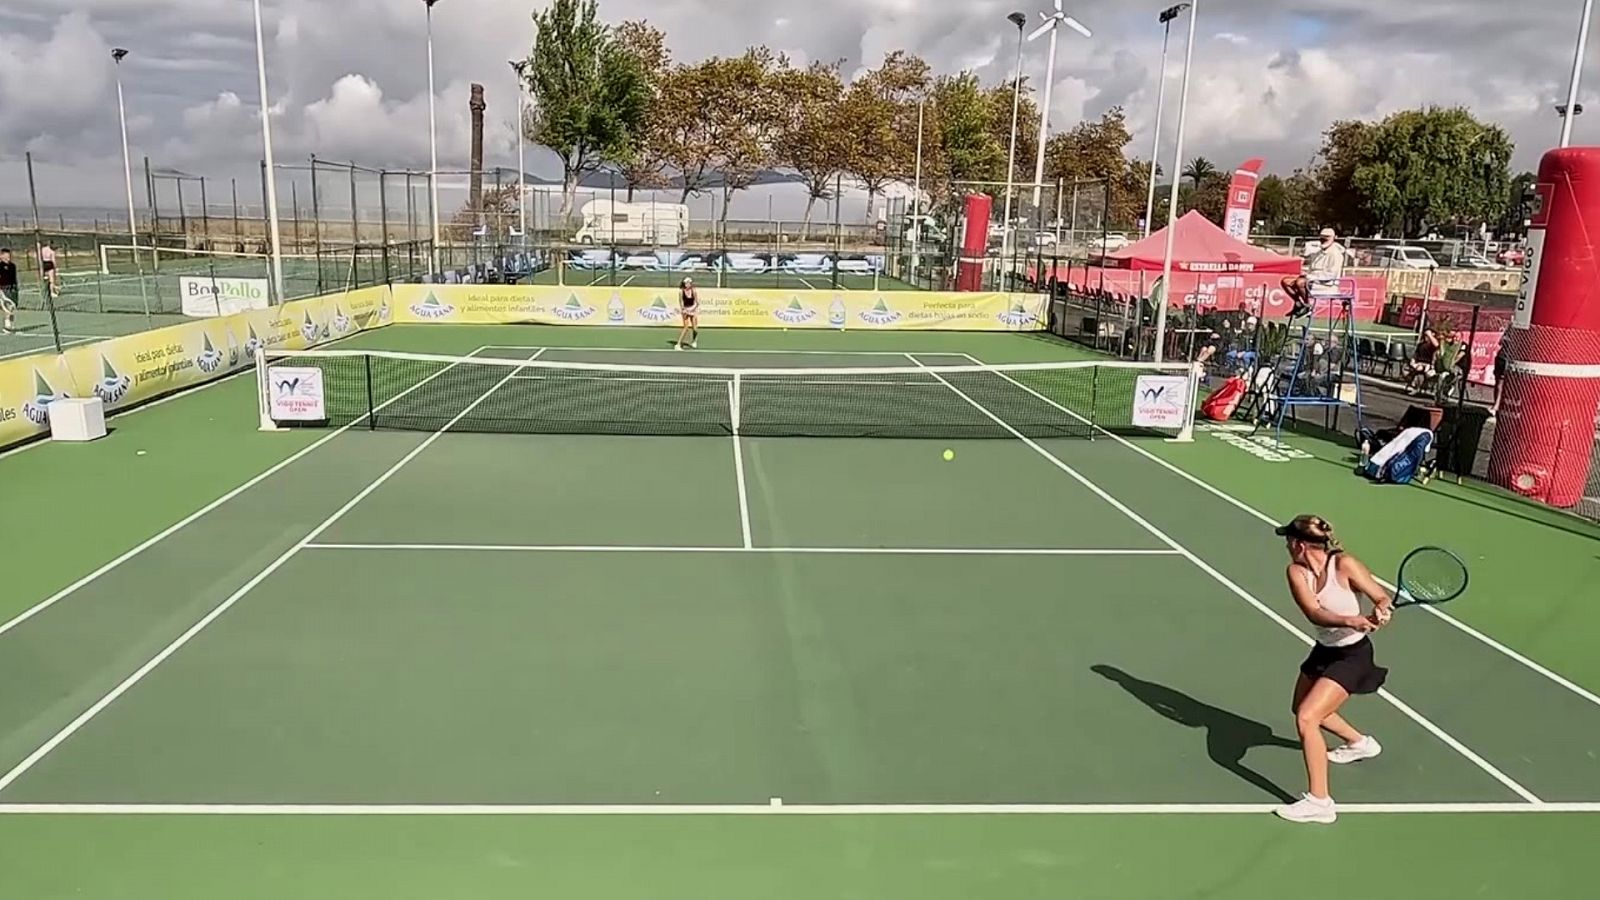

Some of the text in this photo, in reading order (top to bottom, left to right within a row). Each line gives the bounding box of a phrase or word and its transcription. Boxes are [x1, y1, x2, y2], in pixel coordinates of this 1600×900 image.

[1189, 262, 1227, 271] ESTRELLA
[1517, 290, 1527, 311] DE
[409, 305, 455, 318] AGUA SANA
[552, 307, 596, 321] AGUA SANA
[774, 309, 817, 323] AGUA SANA
[858, 312, 902, 325] AGUA SANA
[93, 375, 131, 404] AGUA SANA
[23, 403, 49, 424] AGUA
